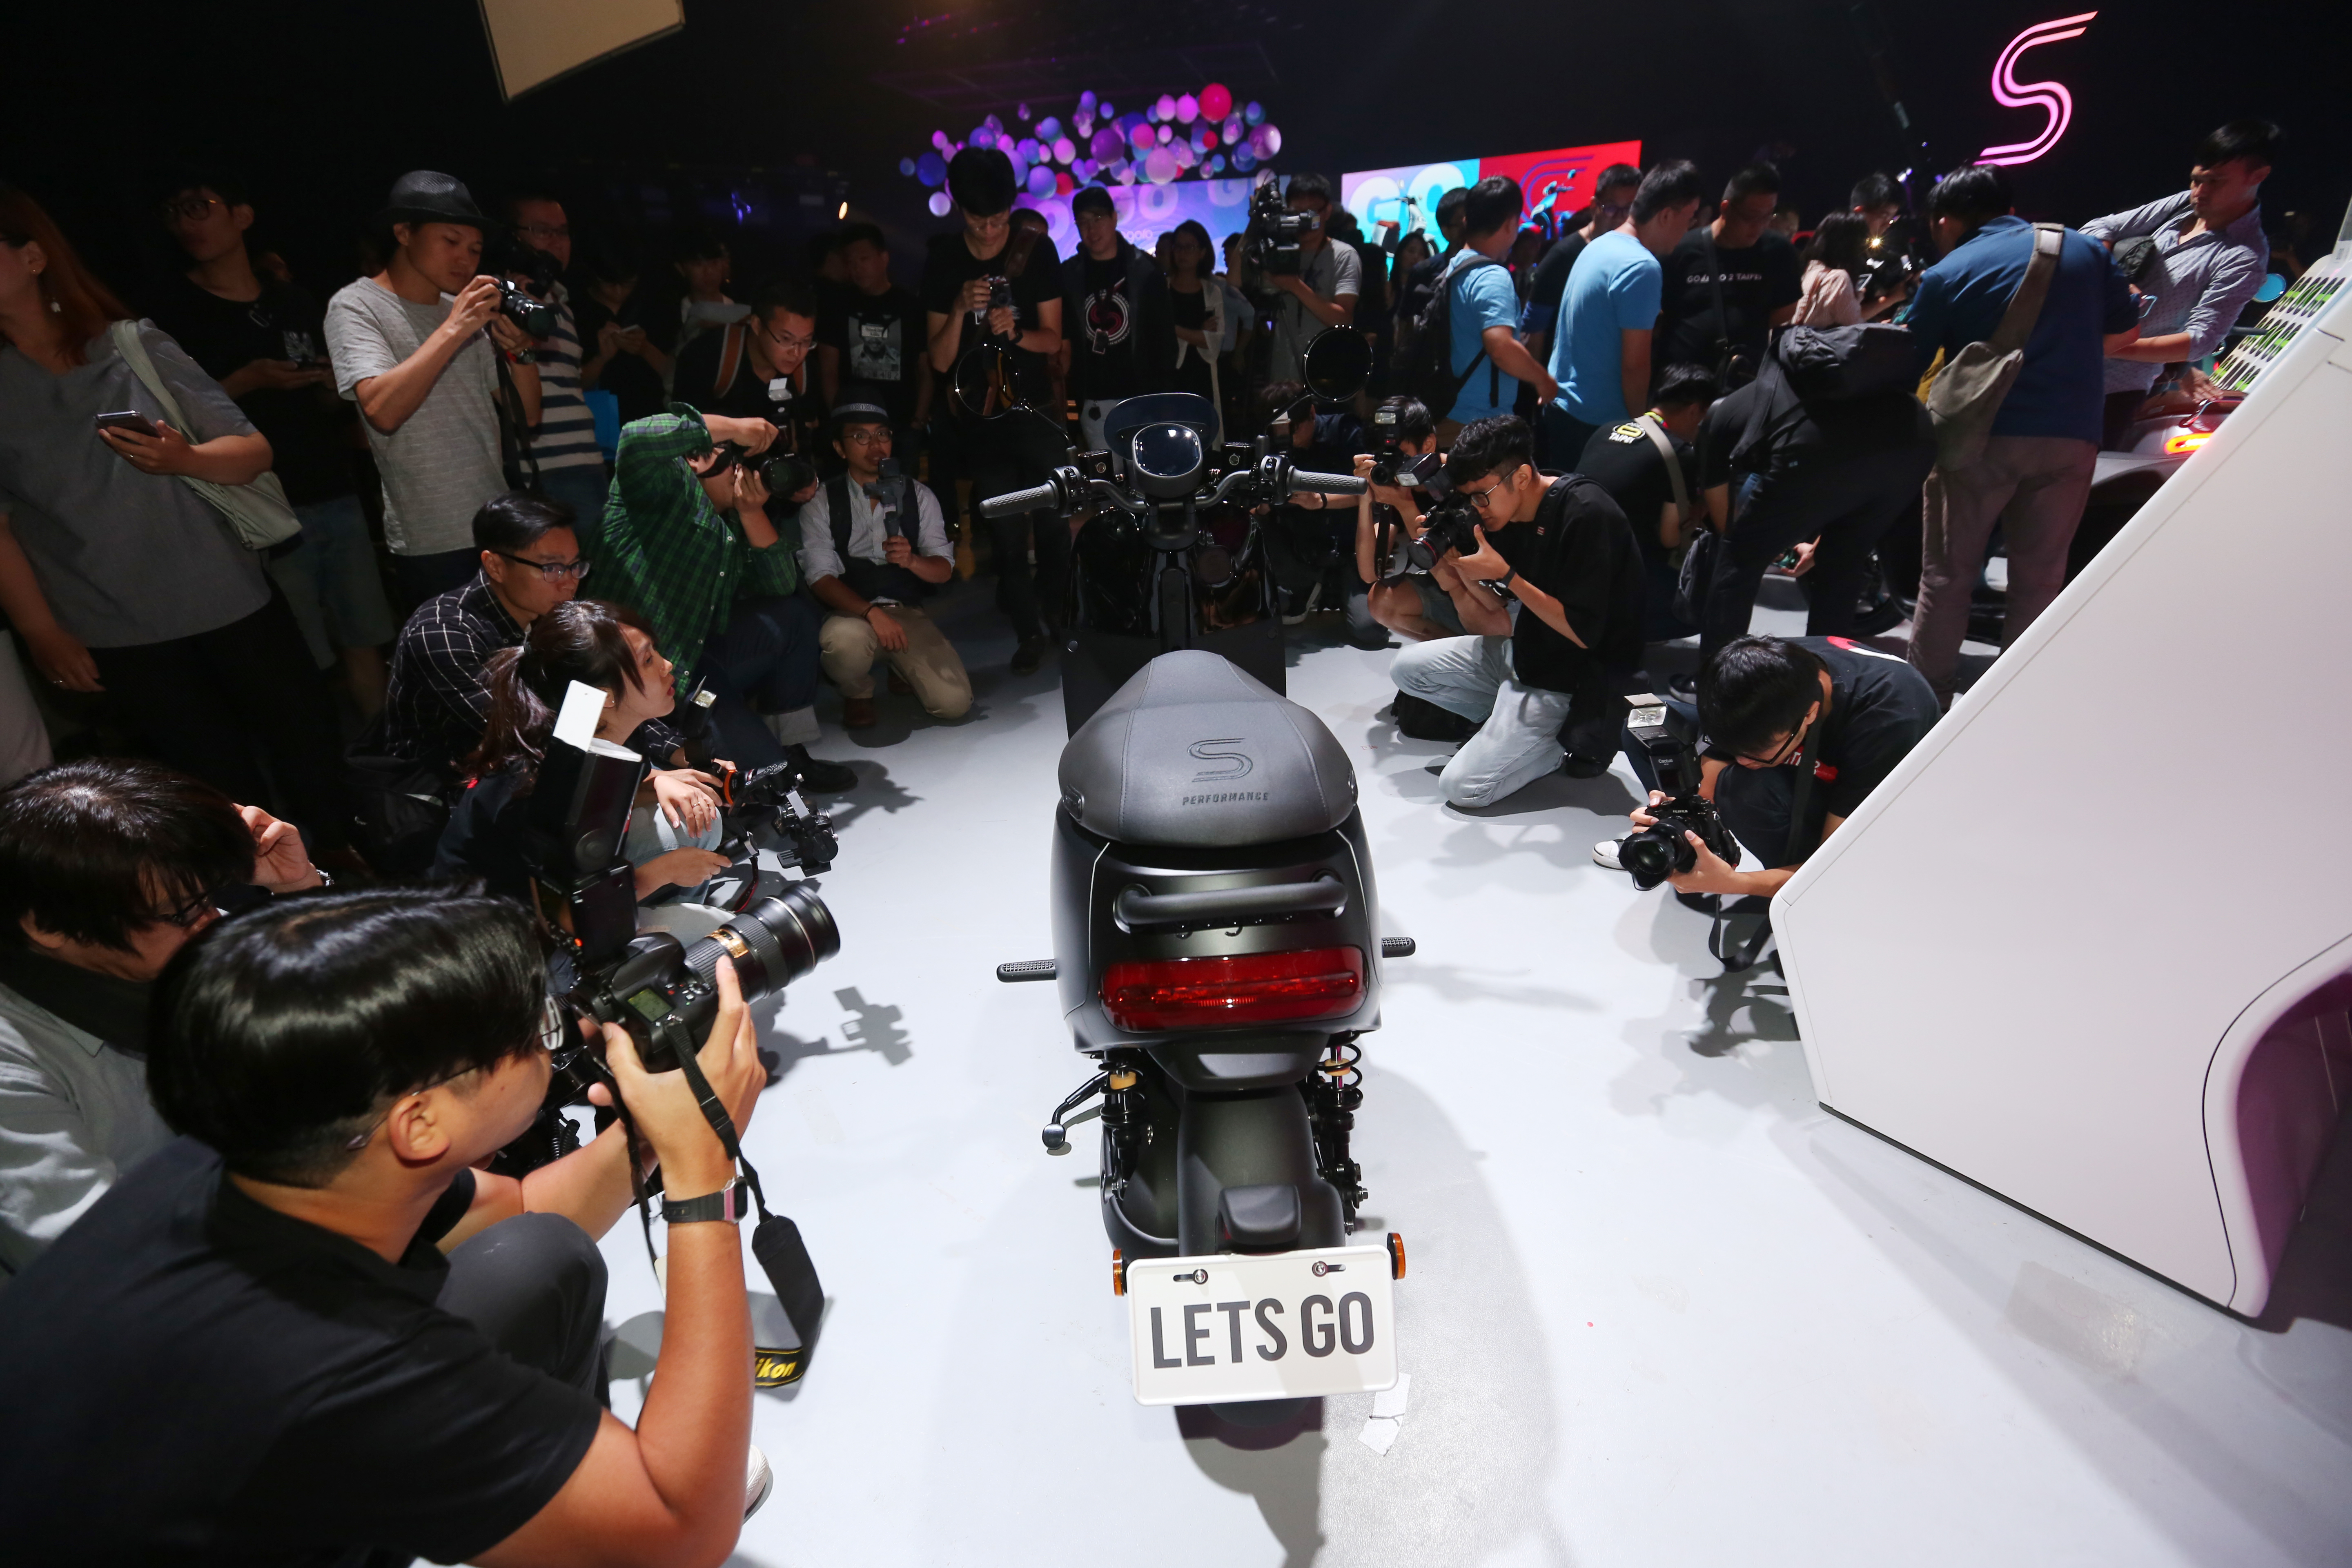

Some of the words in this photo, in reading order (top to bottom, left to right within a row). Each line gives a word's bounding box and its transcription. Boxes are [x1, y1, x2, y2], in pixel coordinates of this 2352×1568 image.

[1608, 432, 1636, 444] TAIPEI
[1182, 791, 1269, 806] PERFORMANCE
[1150, 1298, 1287, 1370] LETS
[1301, 1291, 1374, 1358] GO
[755, 1357, 797, 1379] ikon
